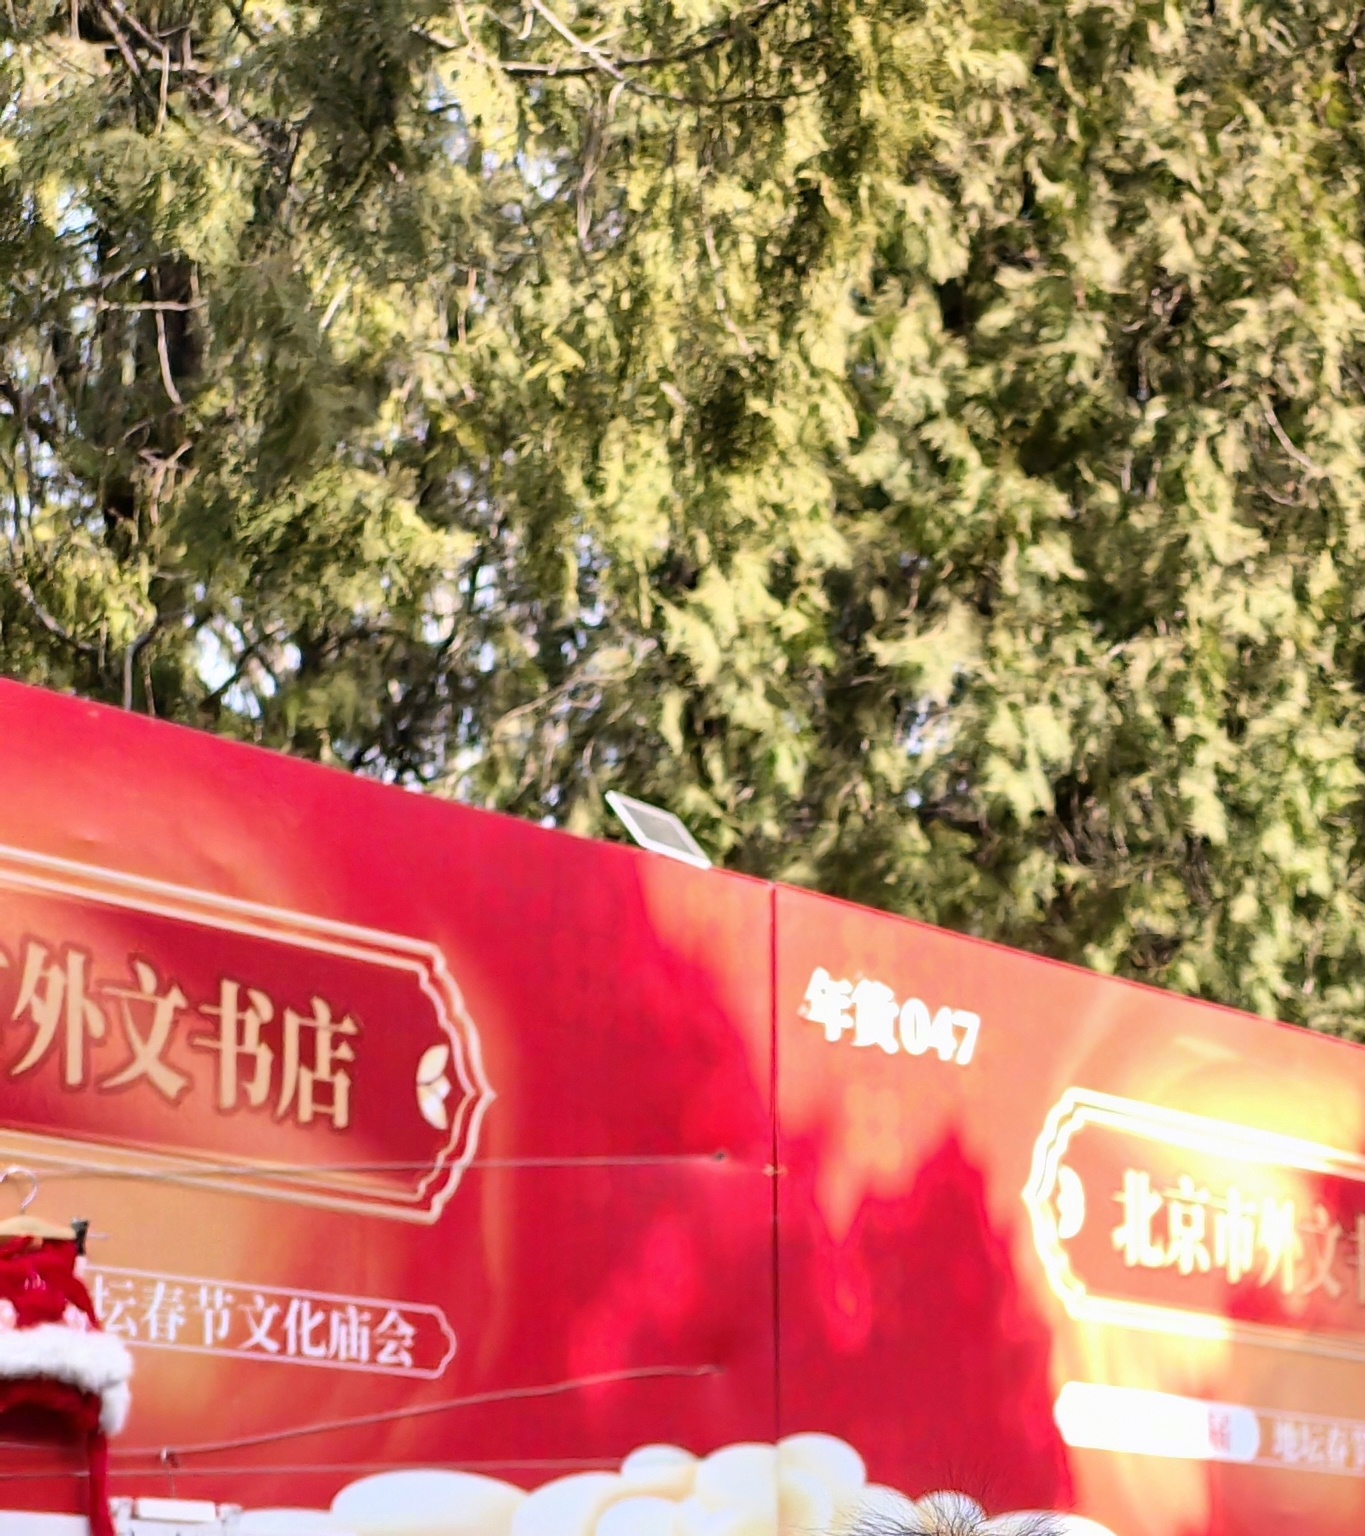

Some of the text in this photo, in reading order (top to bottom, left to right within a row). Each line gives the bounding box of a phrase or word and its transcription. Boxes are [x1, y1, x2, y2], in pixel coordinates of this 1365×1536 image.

[0, 941, 360, 1130] 外文书店
[797, 966, 982, 1066] 年货047
